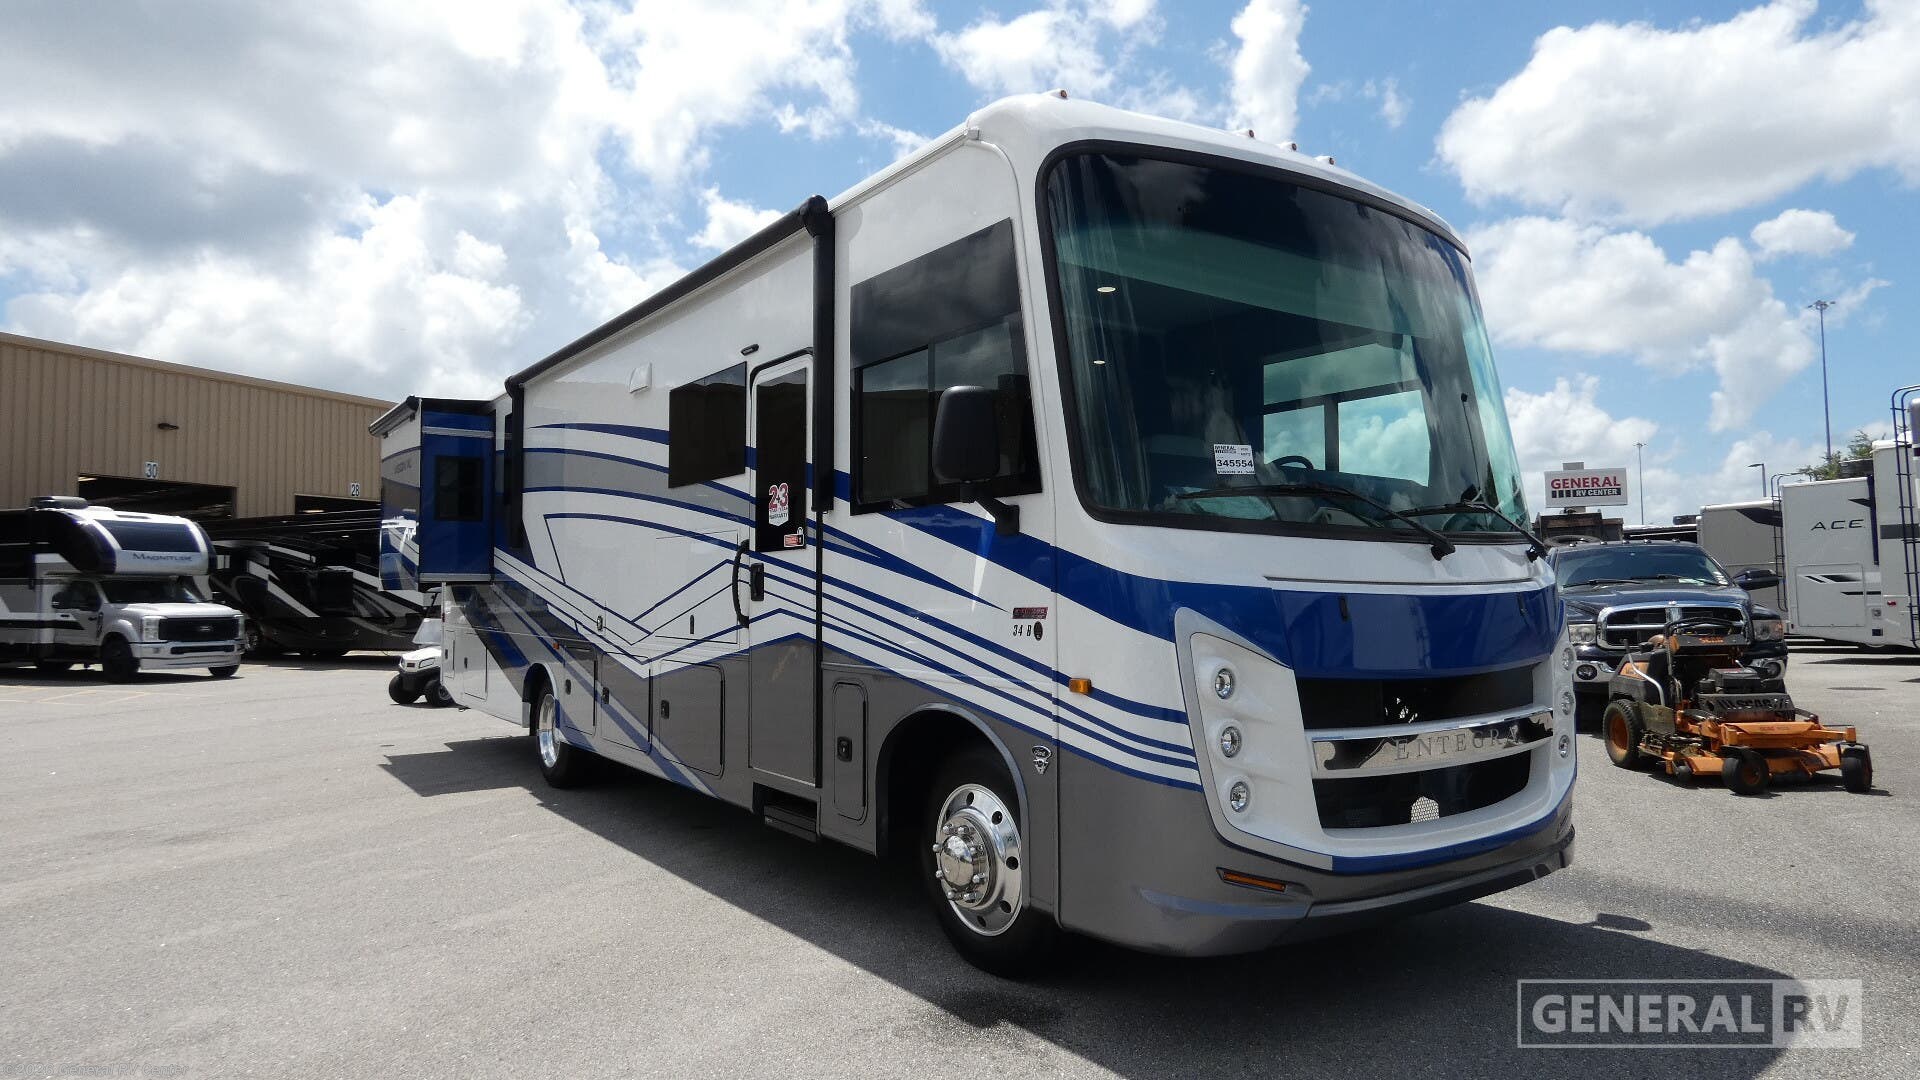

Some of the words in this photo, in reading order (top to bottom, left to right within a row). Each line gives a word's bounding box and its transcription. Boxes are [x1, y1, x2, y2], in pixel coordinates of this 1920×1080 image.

[1216, 459, 1254, 468] 345554
[146, 463, 157, 478] 30
[1551, 476, 1621, 489] GENERAL
[351, 484, 360, 497] 28
[1811, 519, 1864, 531] ACE
[1013, 625, 1023, 636] 34
[1394, 723, 1520, 760] ENTEGRA
